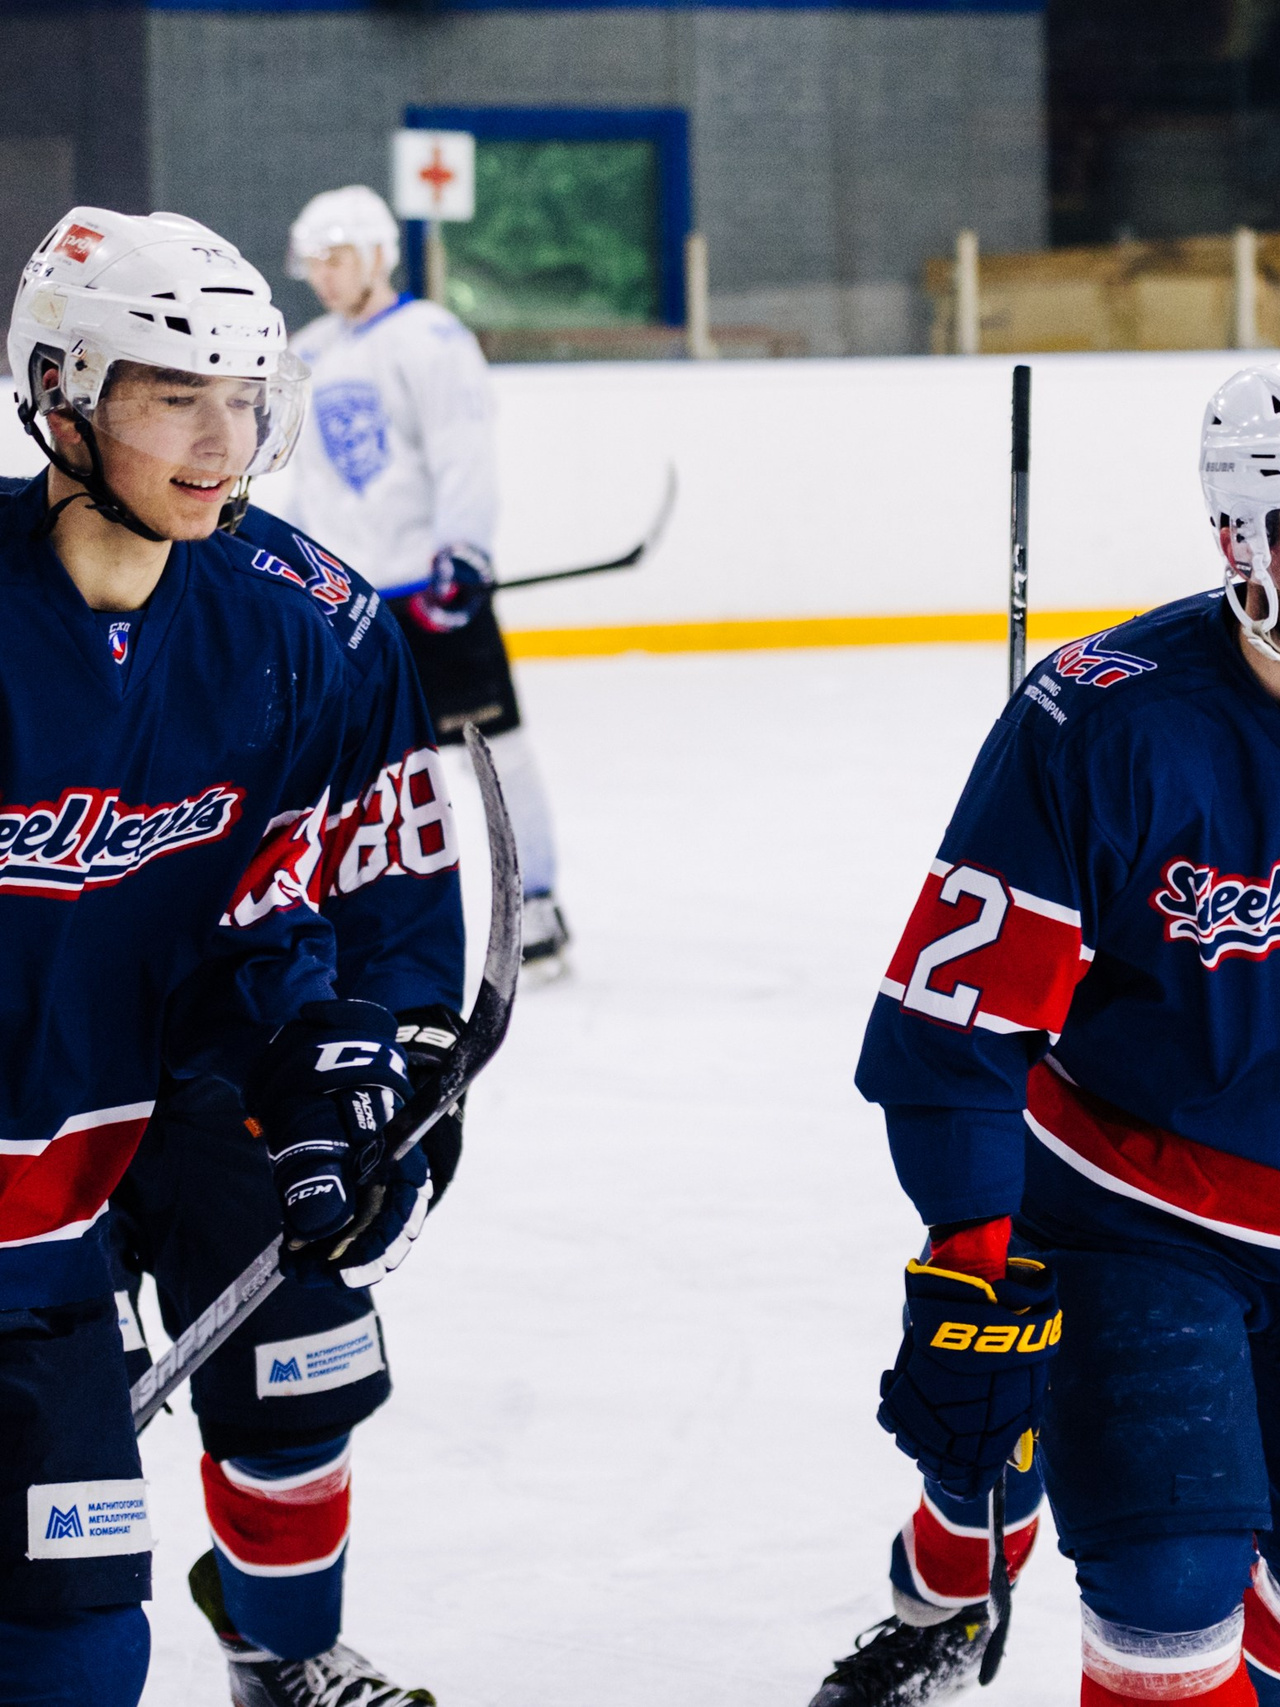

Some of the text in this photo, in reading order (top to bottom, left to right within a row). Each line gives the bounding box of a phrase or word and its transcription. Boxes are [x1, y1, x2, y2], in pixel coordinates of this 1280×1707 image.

[287, 1183, 334, 1207] CCM
[929, 1308, 1064, 1354] BAUE
[88, 1525, 131, 1537] КОМБИНАТ
